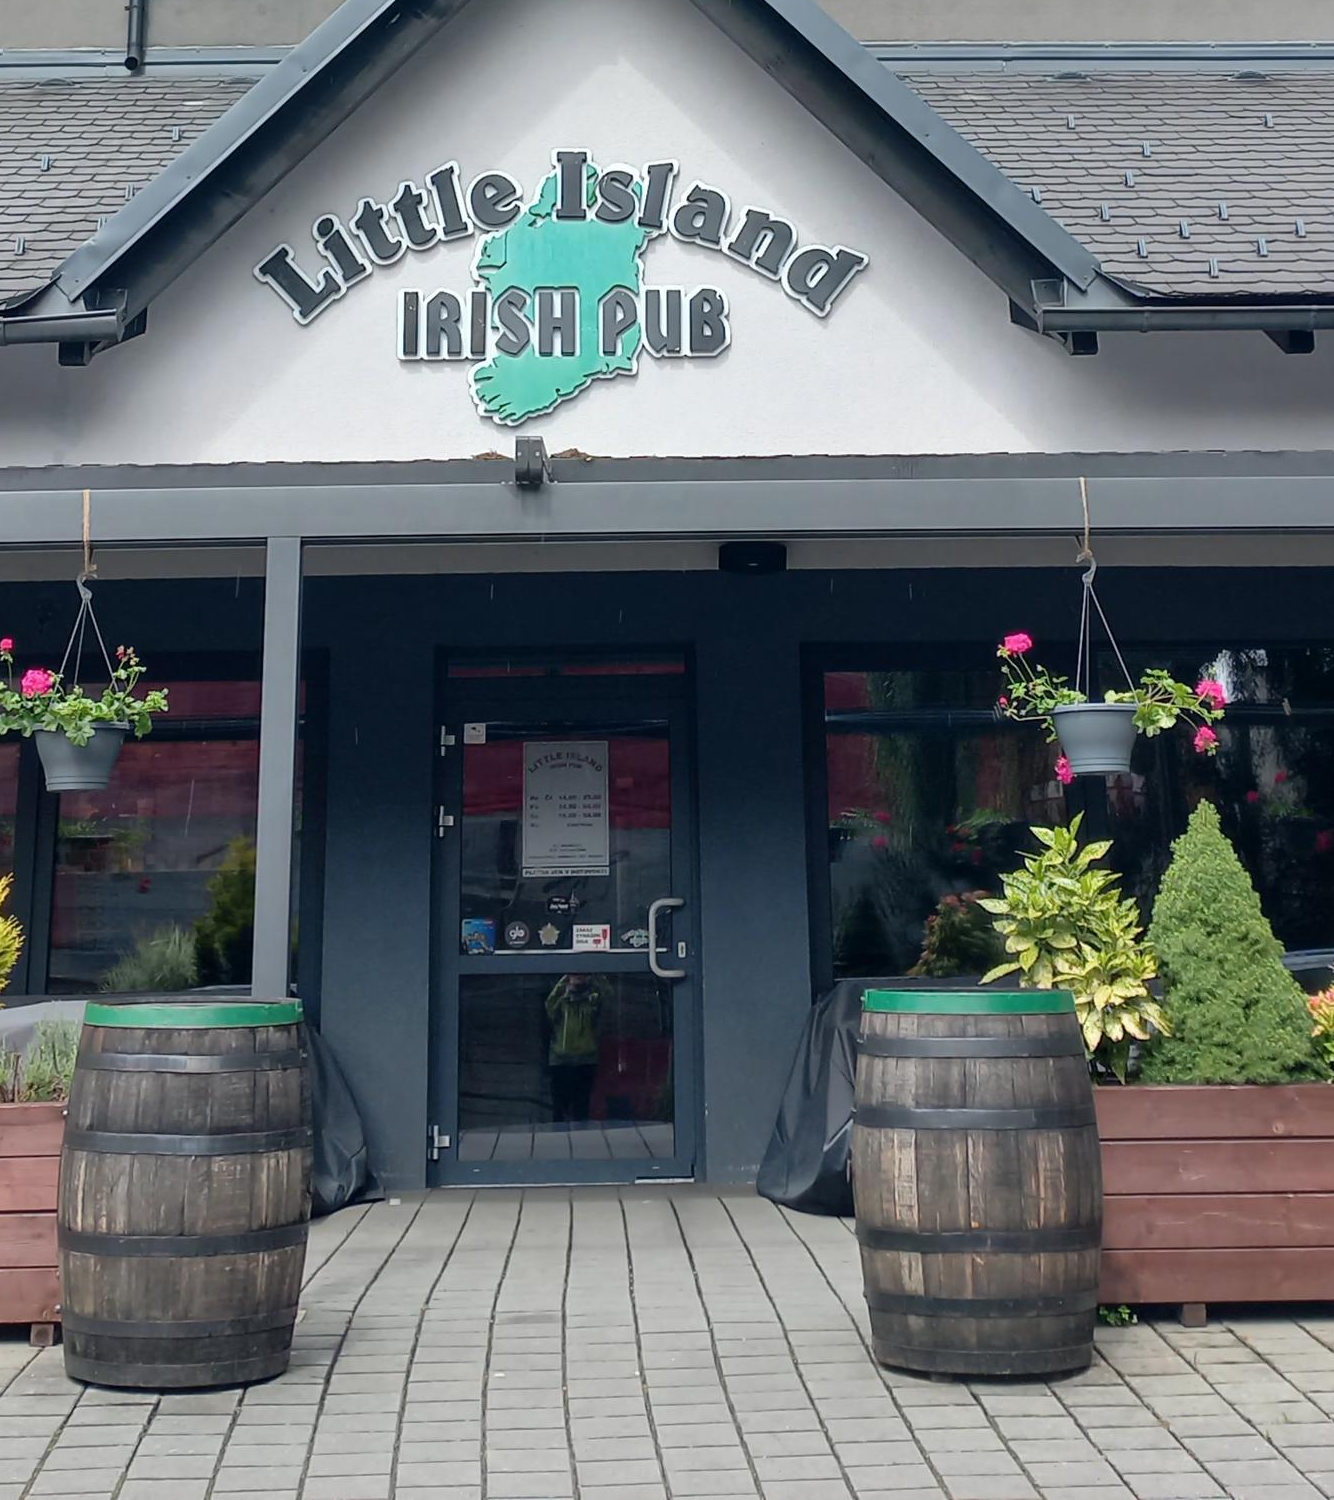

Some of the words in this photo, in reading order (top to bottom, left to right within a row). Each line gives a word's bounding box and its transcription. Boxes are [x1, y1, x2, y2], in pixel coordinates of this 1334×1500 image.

[258, 163, 524, 321] Little
[553, 150, 864, 314] Island
[400, 289, 578, 357] IRISH
[598, 289, 730, 357] PUB
